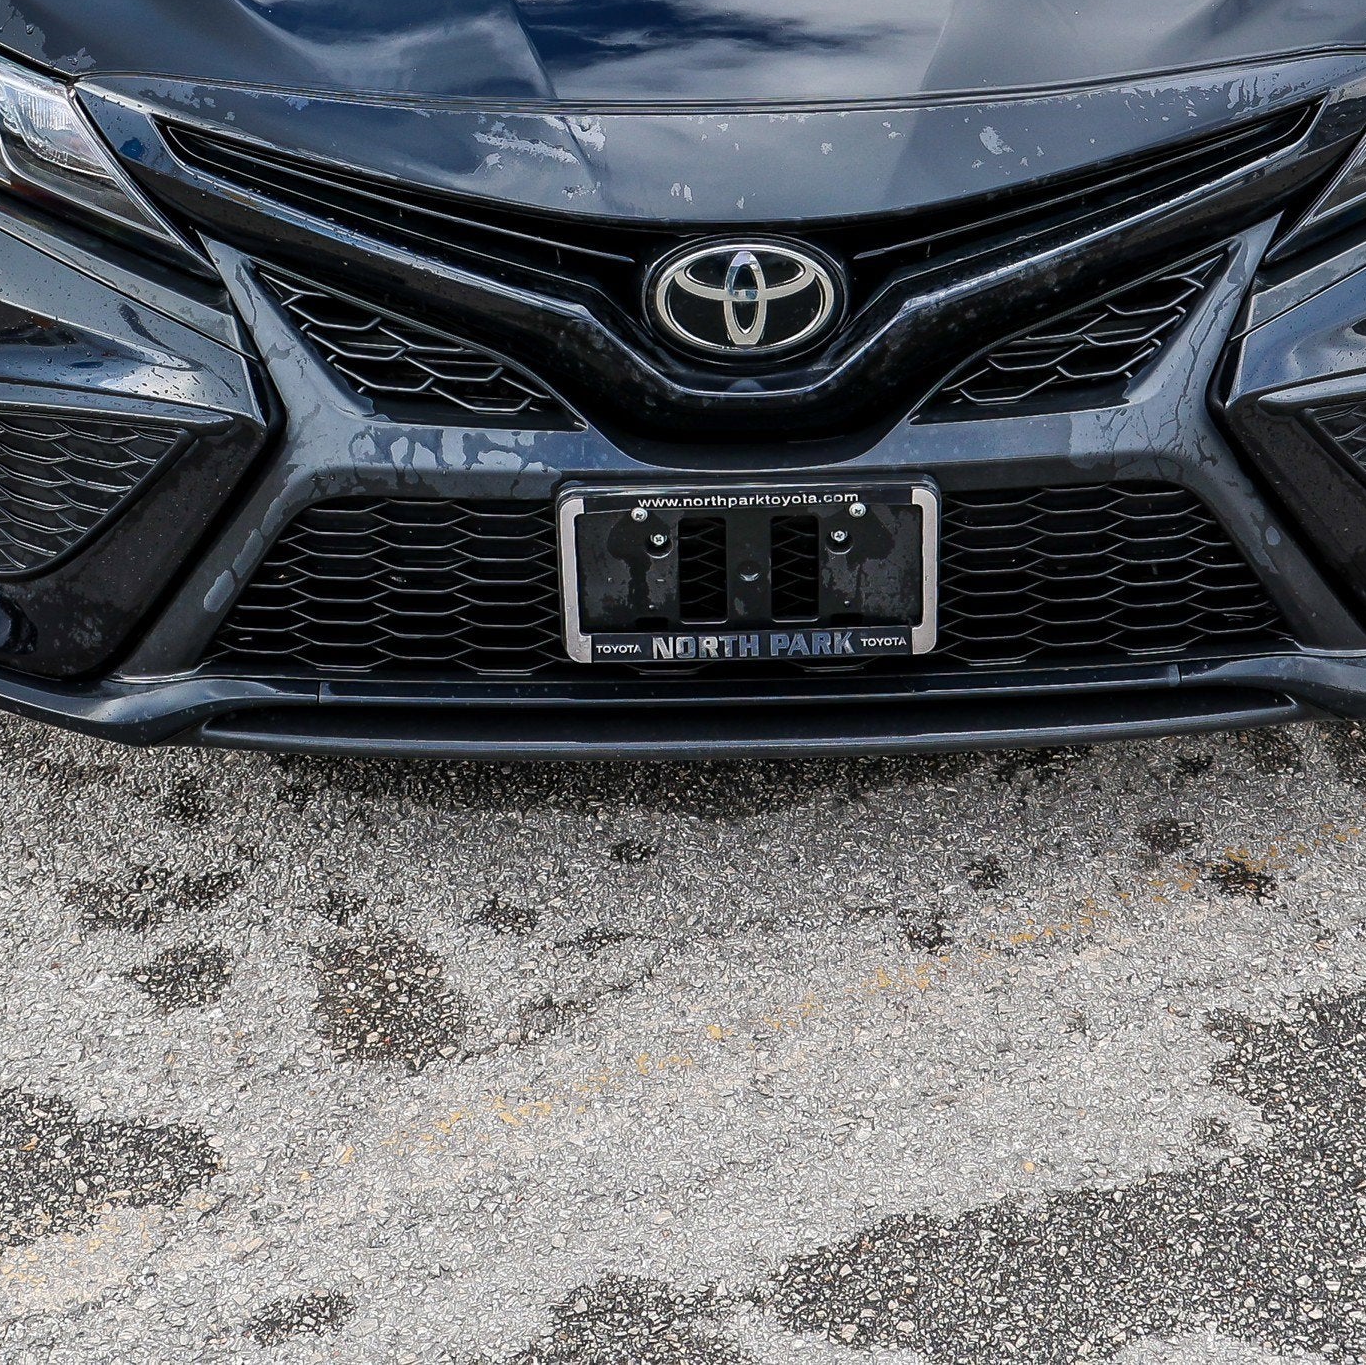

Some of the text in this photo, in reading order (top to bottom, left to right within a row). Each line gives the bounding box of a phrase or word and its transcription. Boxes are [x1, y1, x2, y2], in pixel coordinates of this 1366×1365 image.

[638, 493, 859, 508] www.northparktoyota.com
[596, 631, 908, 659] TOYOTA NORTH PARK TOYOTA
